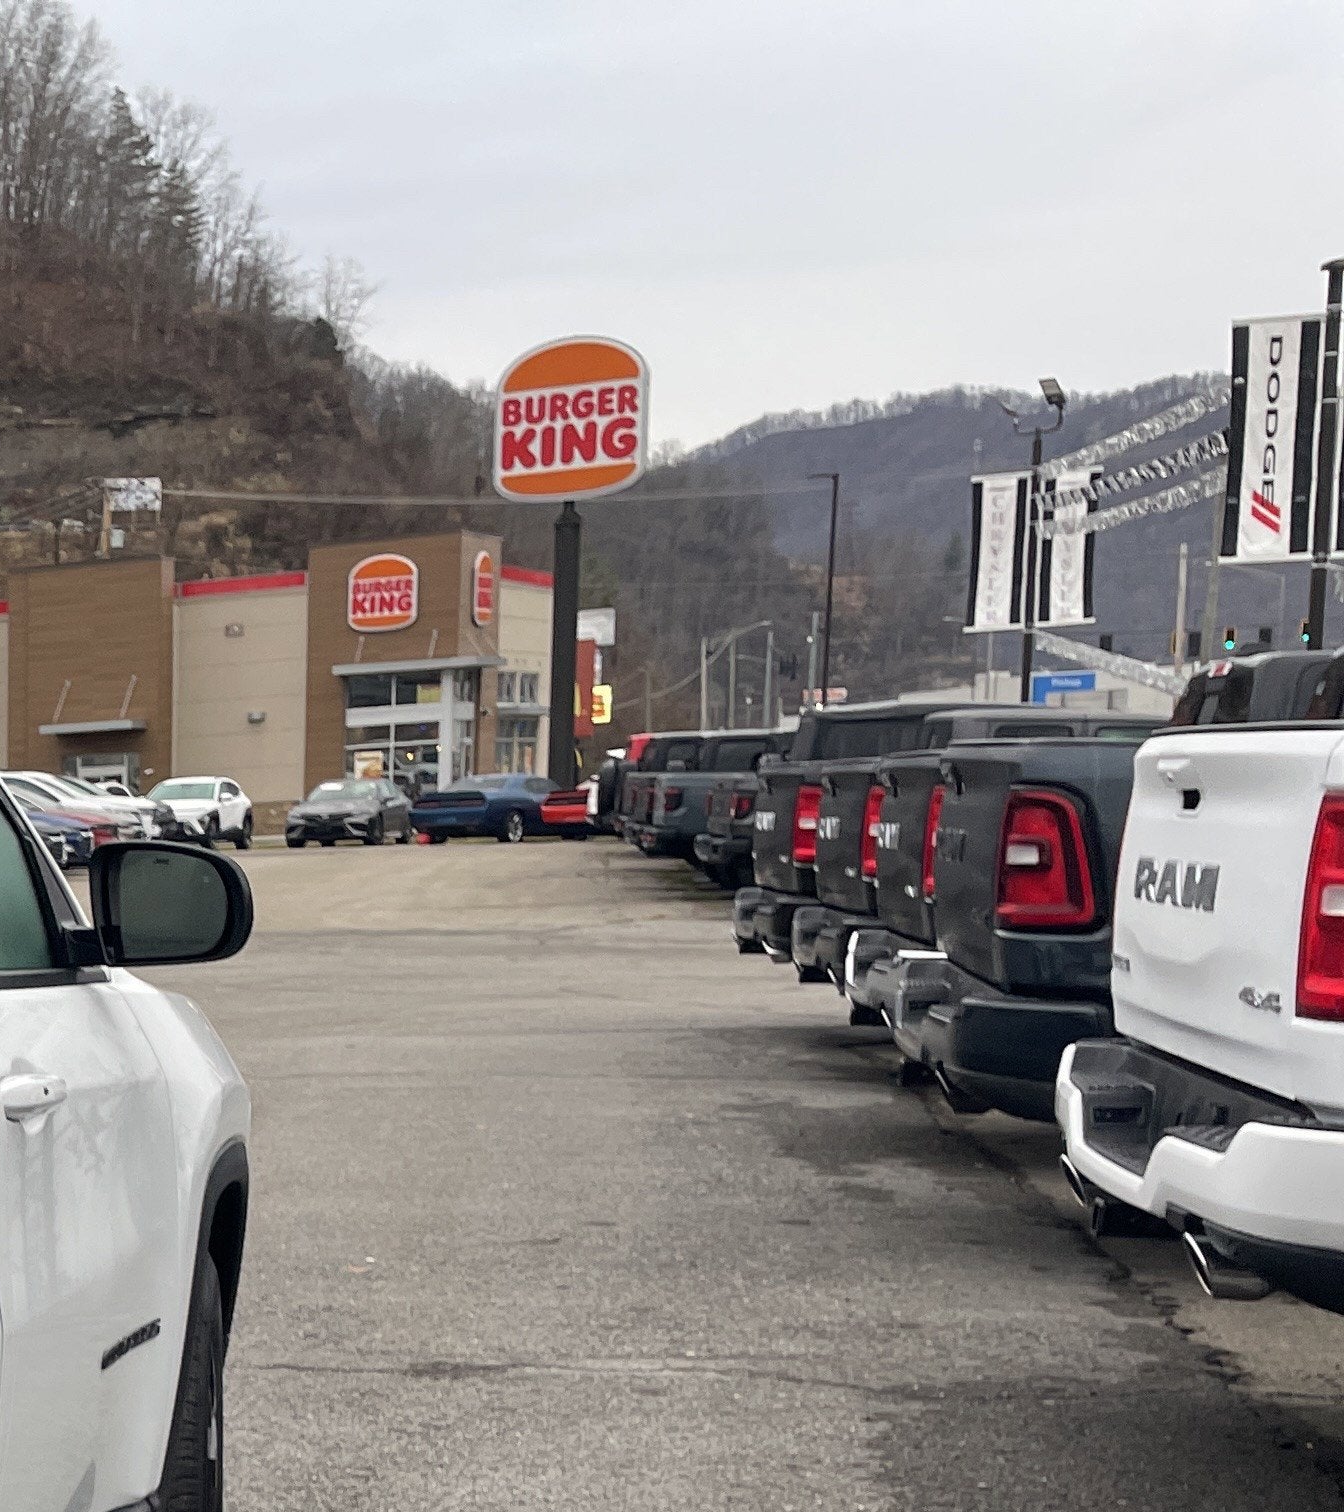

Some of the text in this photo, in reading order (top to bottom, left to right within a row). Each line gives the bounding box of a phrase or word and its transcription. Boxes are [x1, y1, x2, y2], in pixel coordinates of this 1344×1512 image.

[501, 384, 639, 427] BURGER
[1261, 334, 1283, 506] DODGE
[500, 417, 638, 472] KING
[351, 593, 412, 616] KING
[352, 578, 414, 595] BURGER
[1134, 856, 1221, 913] RAM
